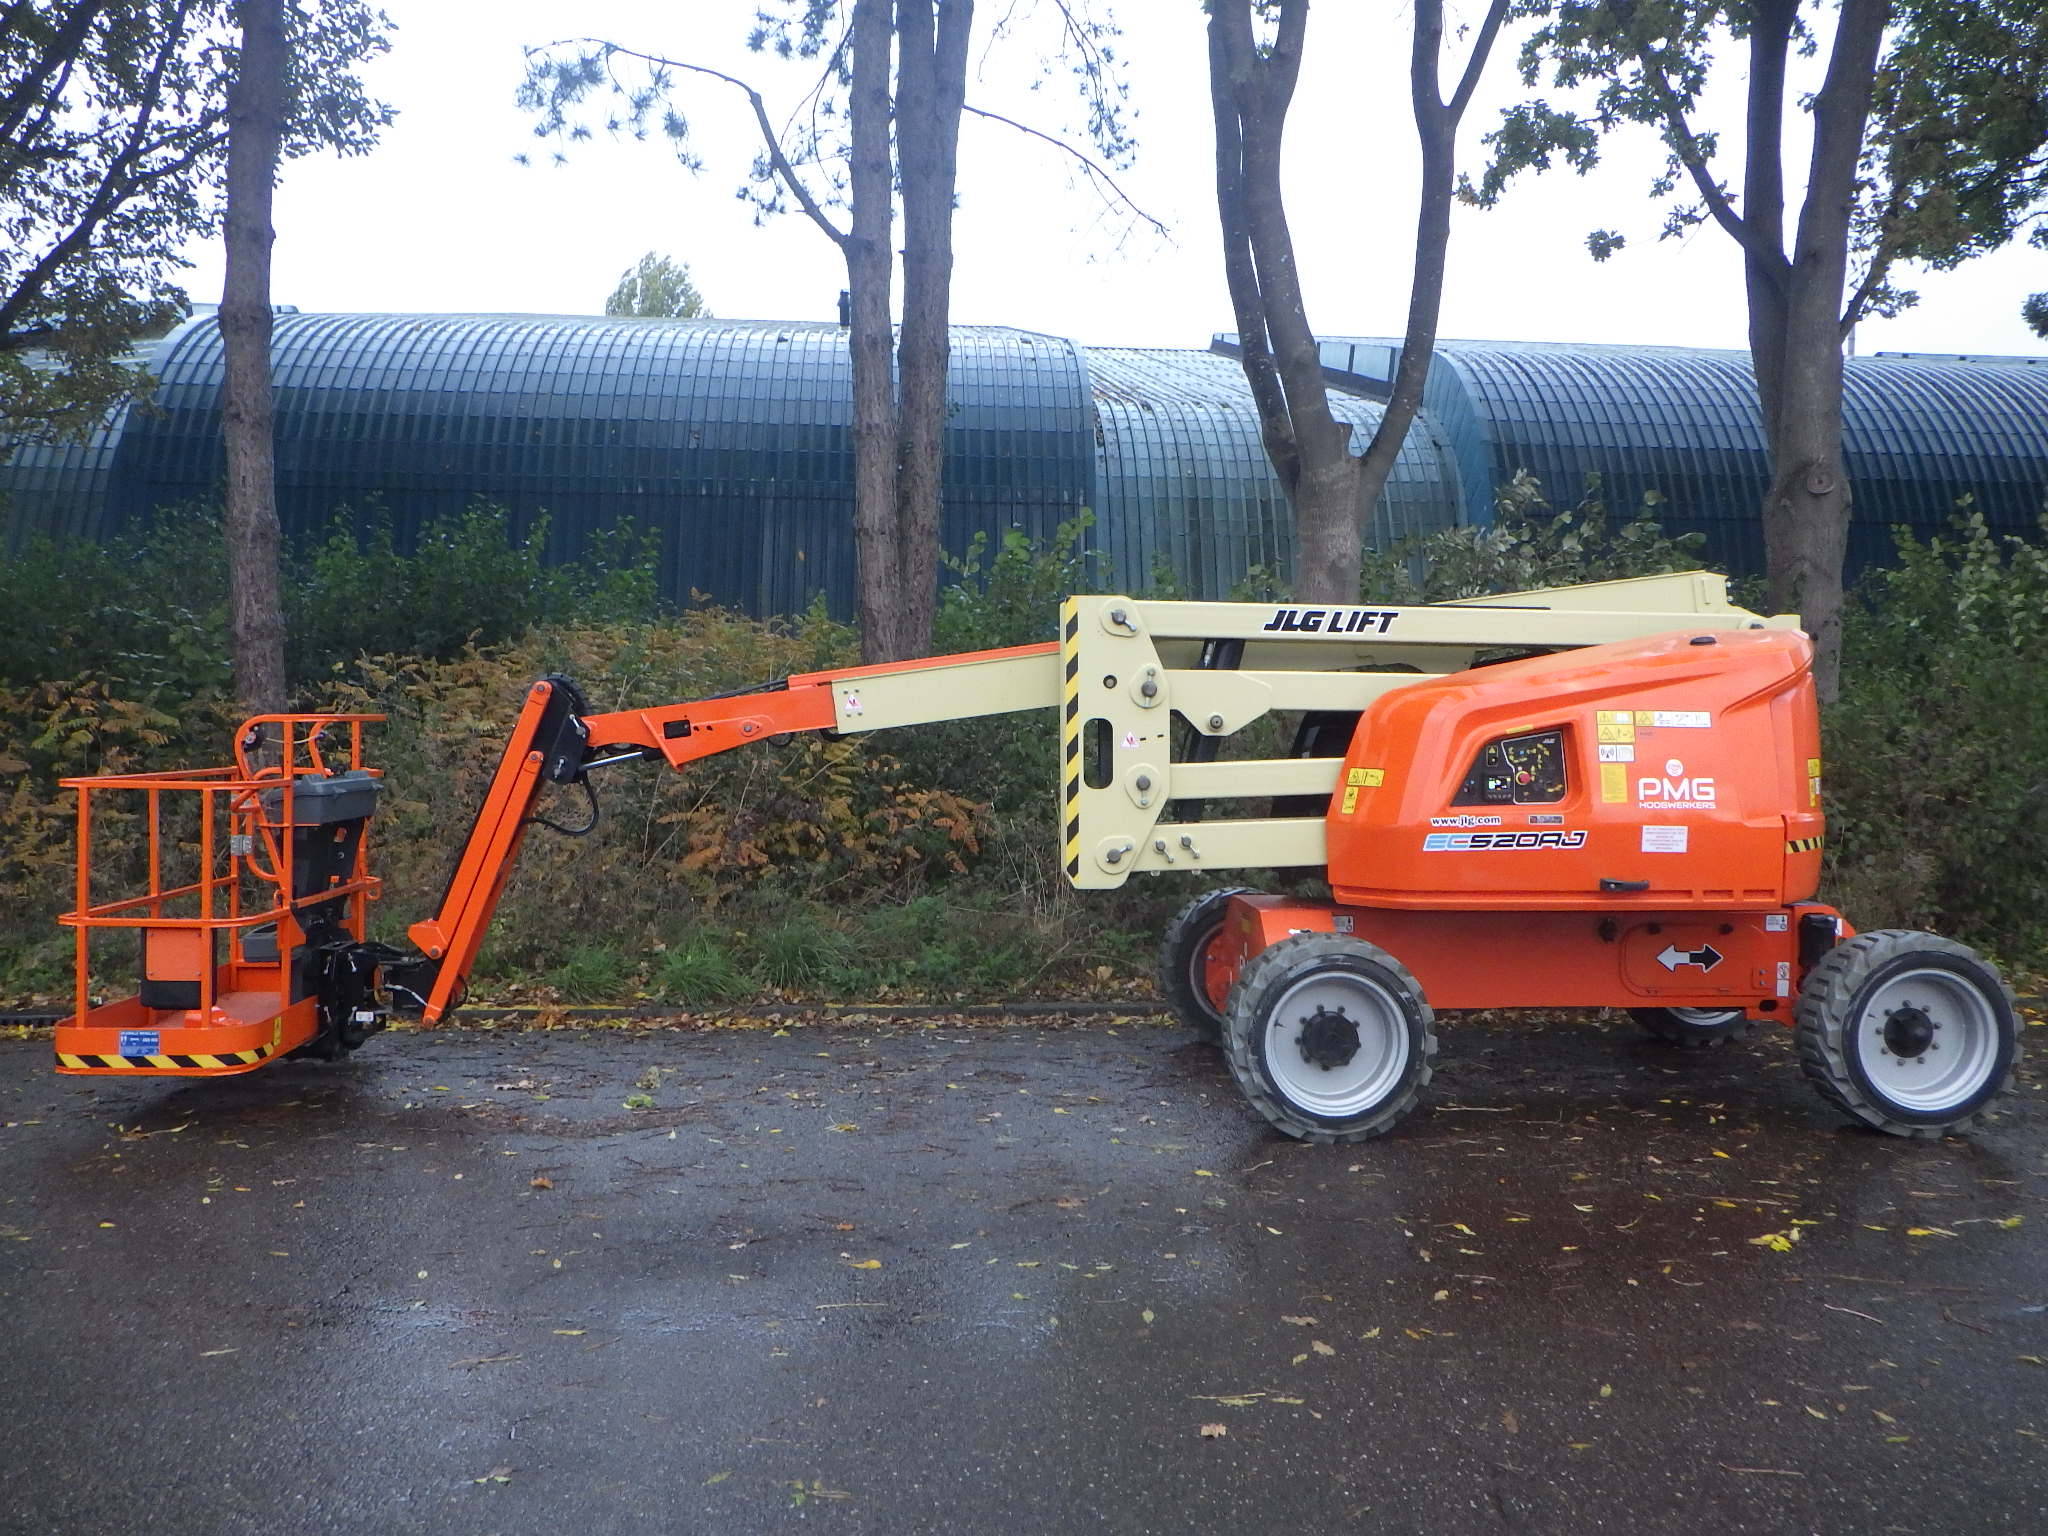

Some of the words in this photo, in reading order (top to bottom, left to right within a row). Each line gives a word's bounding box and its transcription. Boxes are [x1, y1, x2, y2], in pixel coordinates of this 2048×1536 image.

[1263, 609, 1326, 632] JLG
[1326, 611, 1399, 633] LIFT
[1638, 777, 1716, 801] PMG
[1431, 815, 1502, 826] www.jlg.com
[1425, 832, 1586, 850] EC520AJ
